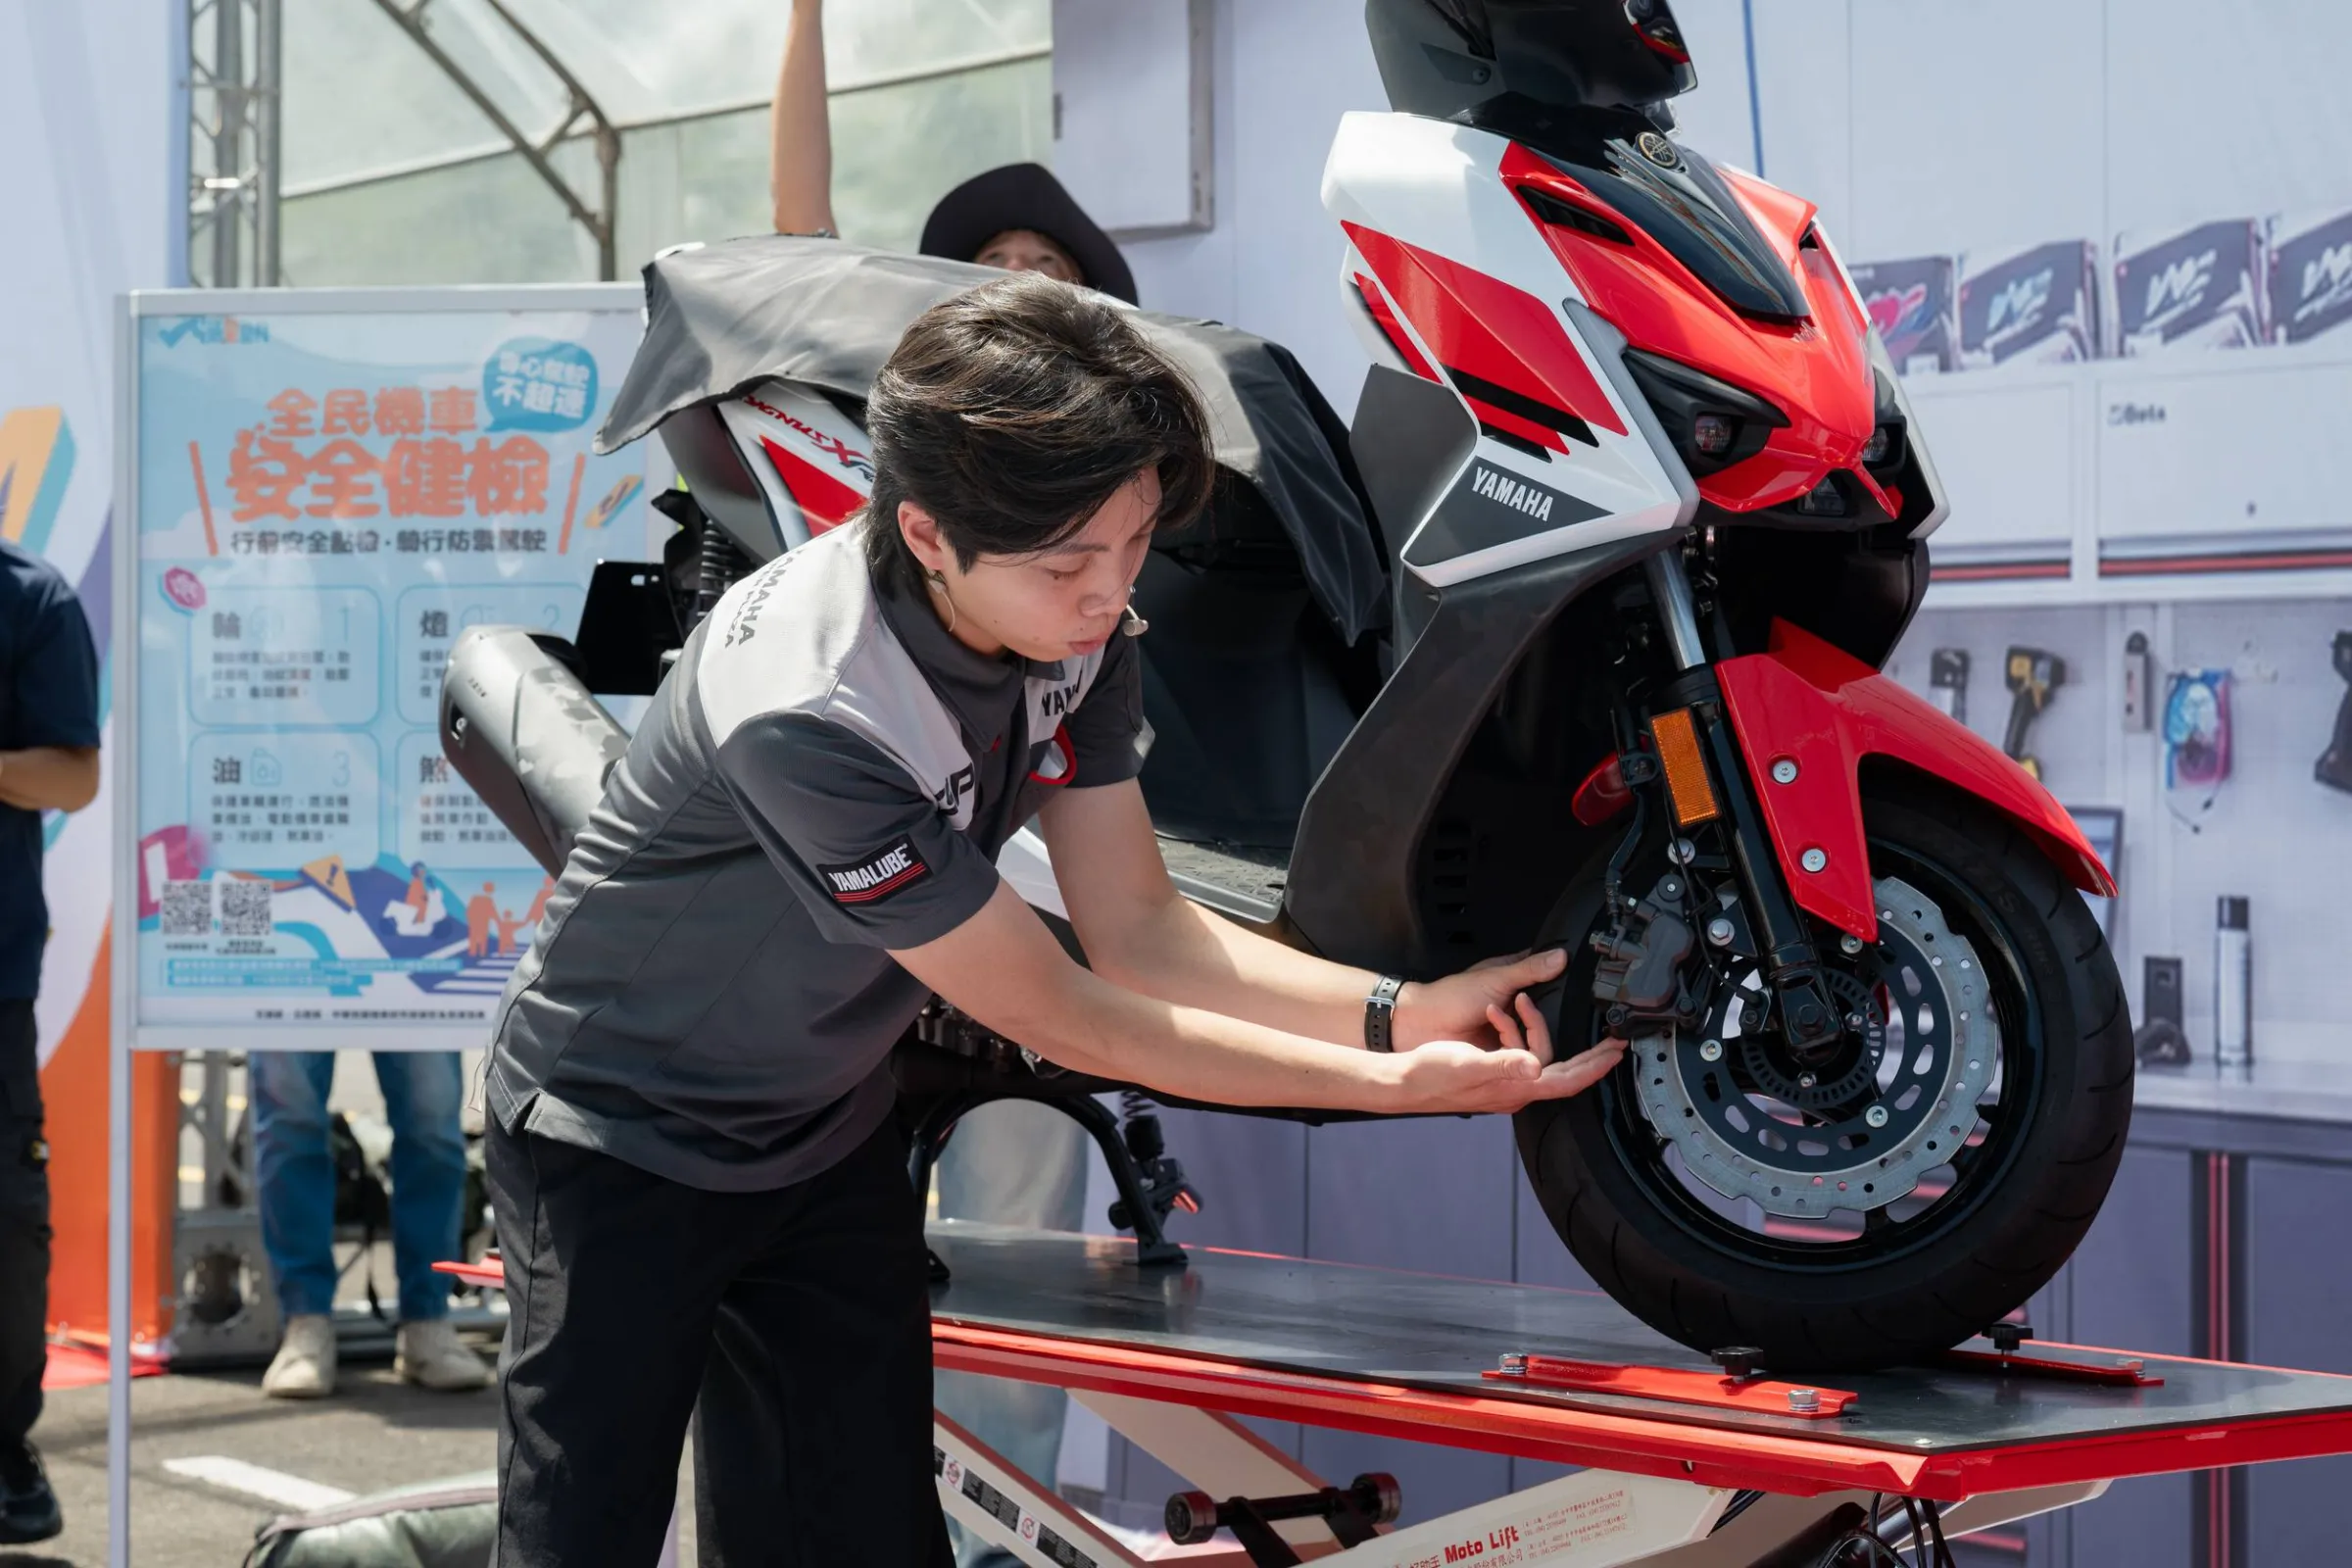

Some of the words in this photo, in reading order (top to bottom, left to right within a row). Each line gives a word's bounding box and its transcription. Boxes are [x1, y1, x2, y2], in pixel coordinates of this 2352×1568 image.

[265, 386, 477, 437] 全民機車
[226, 421, 551, 523] 安全健檢
[1472, 466, 1554, 522] YAMAHA
[212, 757, 241, 785] 油
[331, 751, 352, 788] 3
[828, 843, 912, 891] YAMALUBE
[1445, 1540, 1483, 1564] Moto
[1489, 1526, 1520, 1550] Lift
